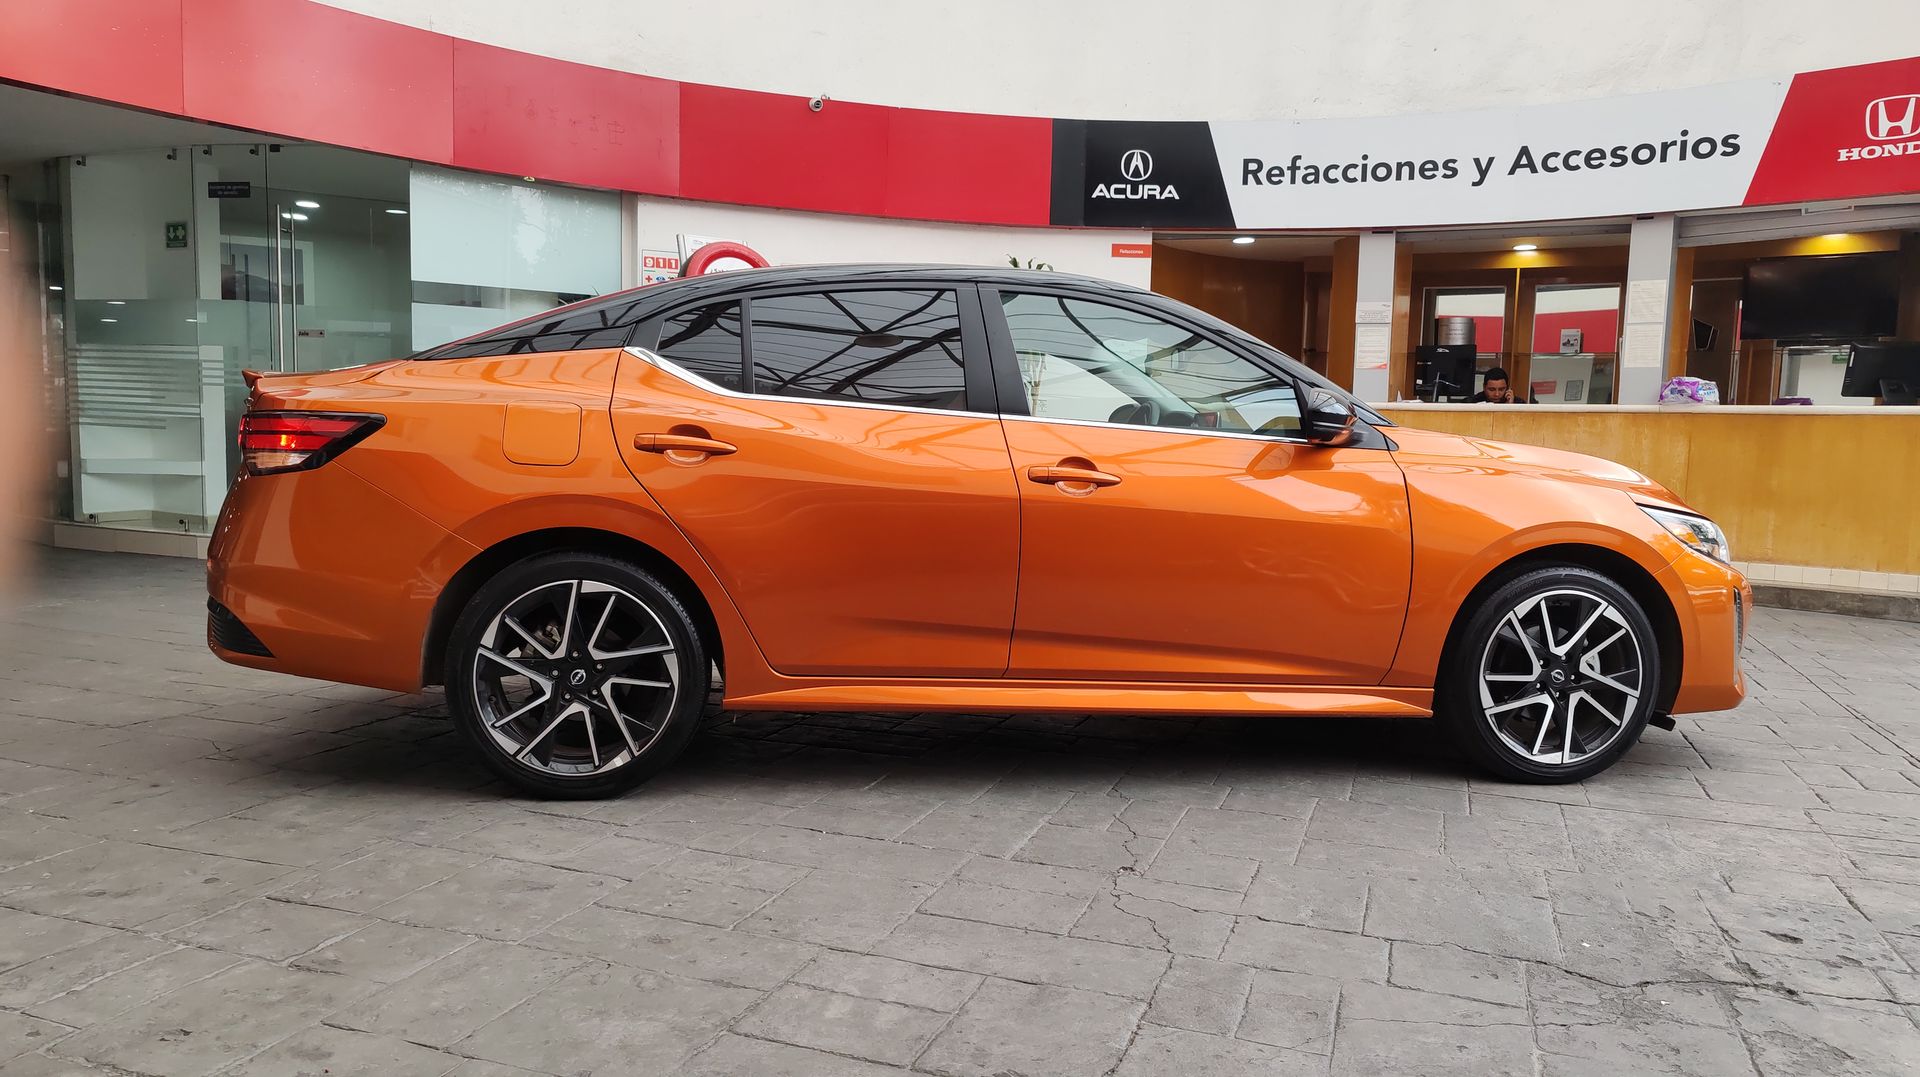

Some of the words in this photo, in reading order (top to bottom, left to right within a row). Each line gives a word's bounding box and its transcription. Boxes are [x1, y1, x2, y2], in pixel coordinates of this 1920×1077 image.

[1242, 154, 1459, 185] Refacciones
[1471, 156, 1495, 187] y
[1507, 129, 1741, 176] Accesorios
[1091, 183, 1180, 200] ACURA
[645, 257, 678, 270] 911
